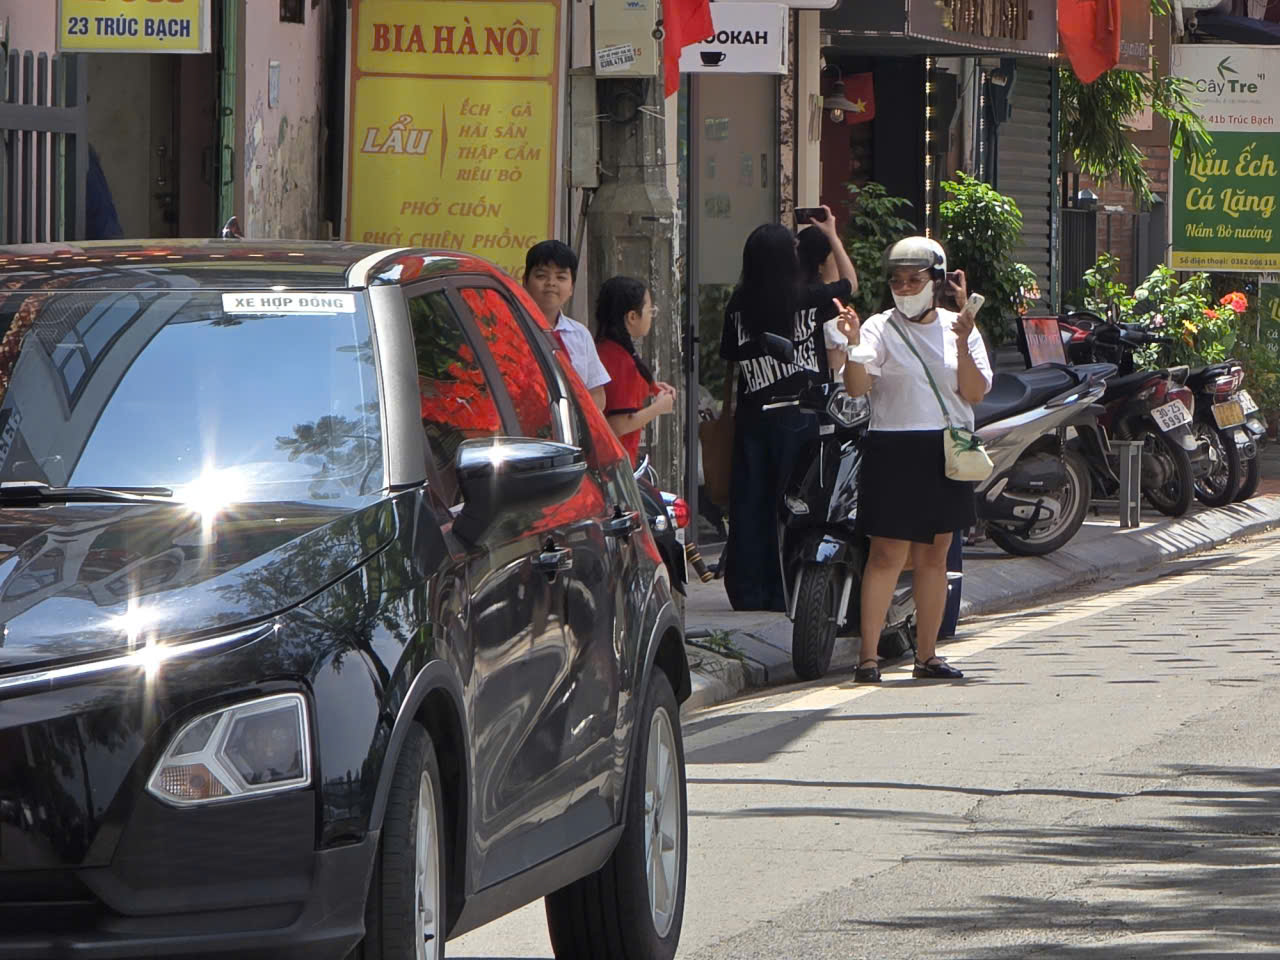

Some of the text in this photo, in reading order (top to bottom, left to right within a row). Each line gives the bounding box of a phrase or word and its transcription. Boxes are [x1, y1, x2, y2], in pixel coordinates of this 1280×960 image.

[68, 13, 190, 41] 23 TRÚC BẠCH
[372, 16, 541, 63] BIA HÀ NỘI
[1195, 78, 1225, 97] Cây
[1227, 79, 1258, 94] Tre
[459, 97, 491, 117] ẾCH
[511, 102, 533, 118] GÀ
[458, 122, 528, 139] HẢI SẢN
[1228, 114, 1249, 125] Trúc
[1250, 115, 1274, 126] Bạch
[360, 113, 433, 156] LẨU
[458, 141, 541, 164] THẬP CẨM
[1188, 142, 1278, 182] Lẩu Ếch
[456, 166, 491, 182] RIÊU
[400, 195, 503, 218] PHỞ CUỐN
[1185, 187, 1276, 218] Cá Lăng
[408, 228, 465, 249] CHIÊN
[472, 227, 537, 249] PHỒNG
[1234, 225, 1273, 242] nướng
[235, 296, 344, 309] XE HỢP ĐỒNG
